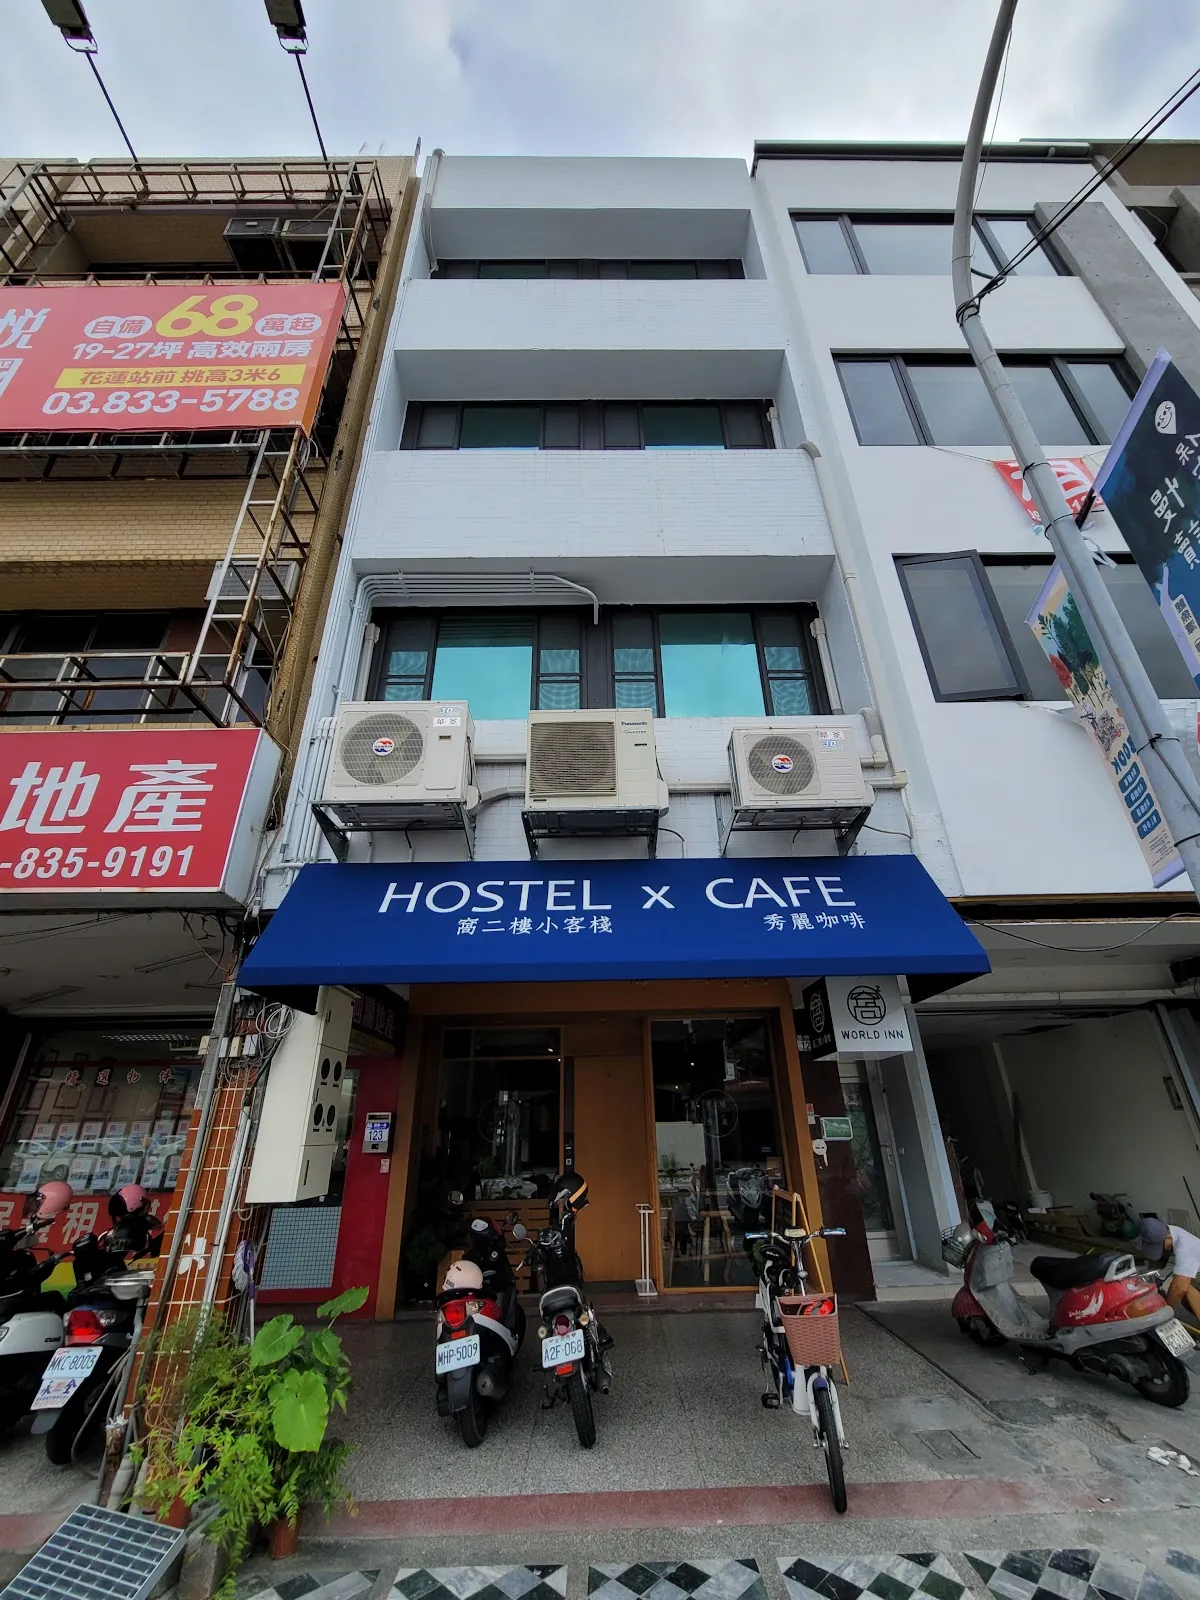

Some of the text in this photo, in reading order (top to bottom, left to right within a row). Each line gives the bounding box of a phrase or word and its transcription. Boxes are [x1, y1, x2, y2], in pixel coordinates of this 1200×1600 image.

[91, 294, 315, 338] 自備 68 萬起
[72, 339, 313, 360] 19-27坪 高效兩房
[80, 366, 281, 385] 花蓮站前 挑高3米6
[42, 388, 299, 414] 03.833-5788
[0, 760, 217, 835] 地產
[379, 879, 612, 913] HOSTEL
[705, 876, 857, 909] CAFE
[456, 915, 613, 935] 窩二樓小客棧
[763, 911, 866, 931] 秀麗咖啡
[841, 1030, 904, 1040] WORLD INN
[64, 1068, 172, 1086] 精選物件
[369, 1130, 383, 1141] 123
[438, 1342, 478, 1367] MHP-5009
[544, 1340, 583, 1362] A2F-068
